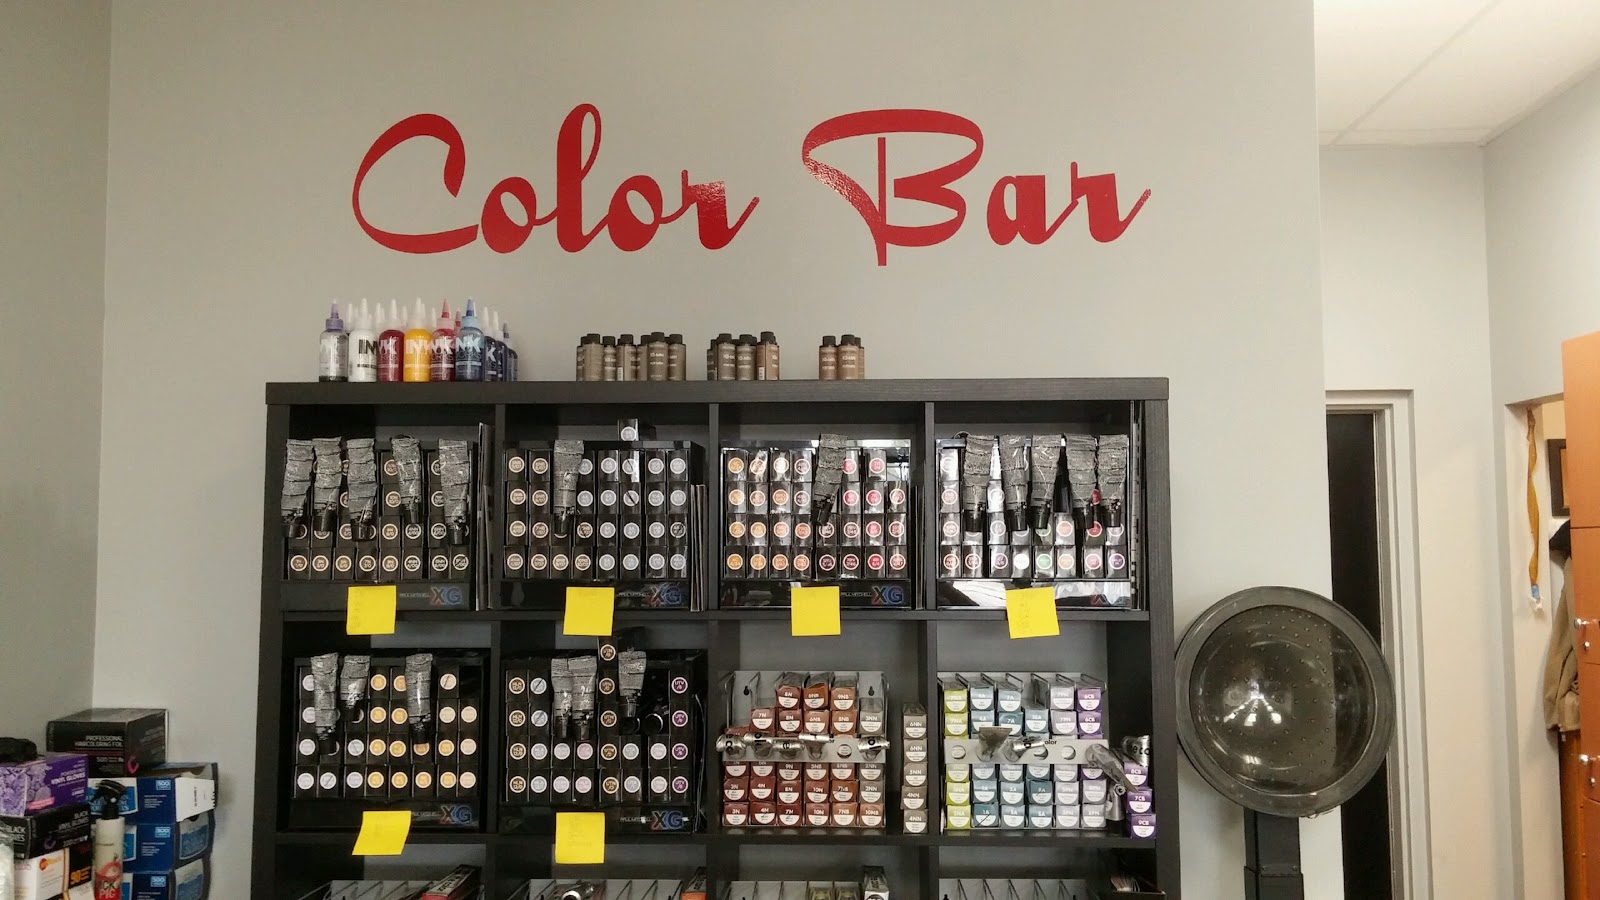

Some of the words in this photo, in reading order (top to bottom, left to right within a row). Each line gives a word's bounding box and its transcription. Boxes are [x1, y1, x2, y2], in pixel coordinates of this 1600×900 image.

[352, 103, 760, 254] Color
[802, 109, 1151, 266] Bar
[359, 339, 378, 356] IN
[431, 586, 463, 605] XG
[651, 583, 682, 606] XG
[872, 585, 904, 605] XG
[440, 805, 472, 825] XG
[651, 810, 684, 830] XG
[100, 889, 115, 899] PIG
